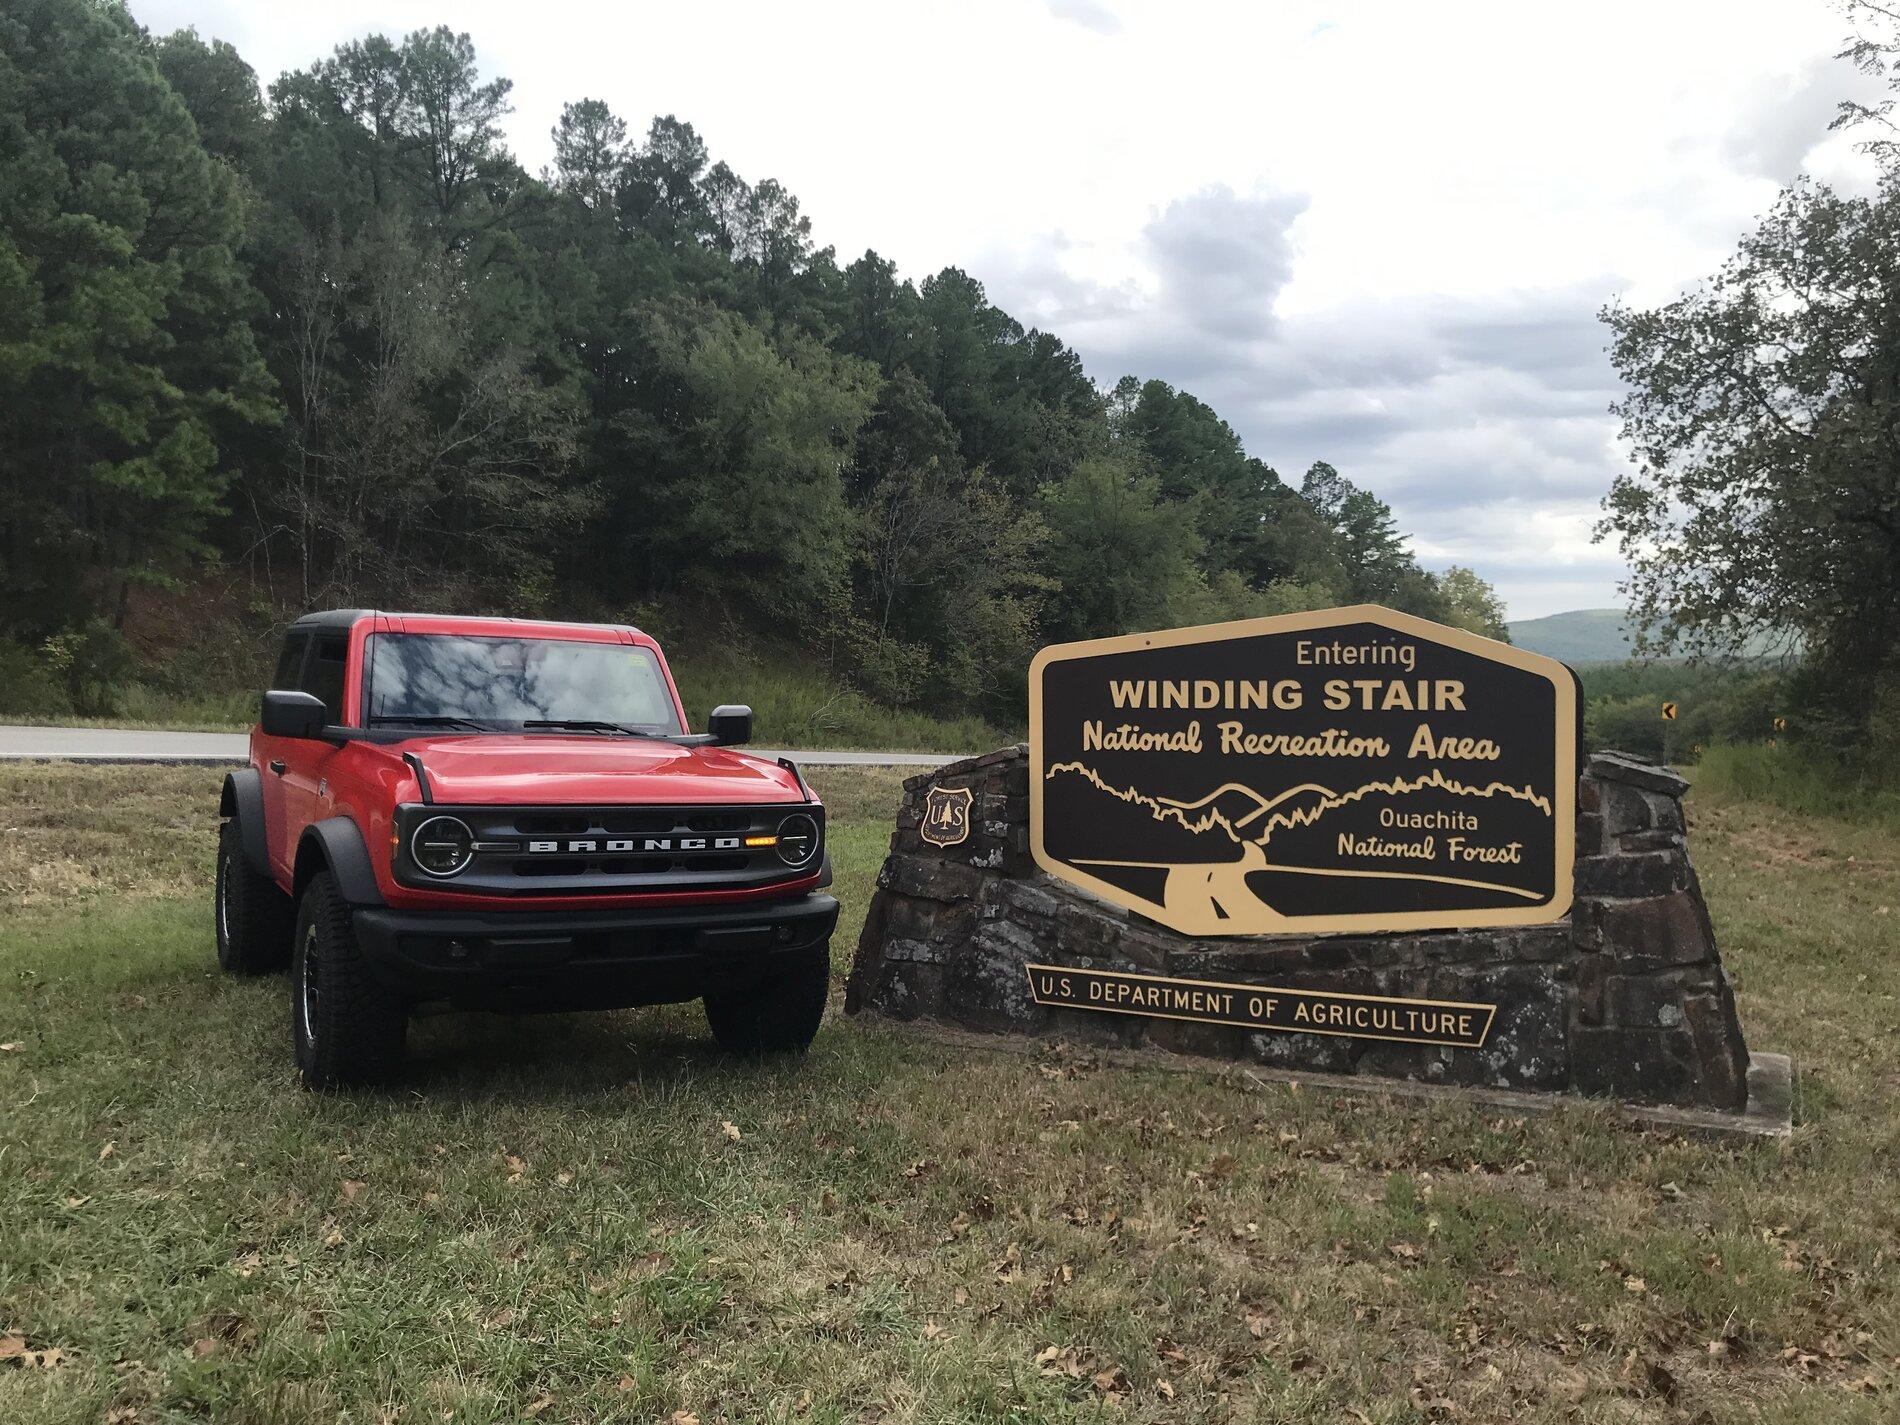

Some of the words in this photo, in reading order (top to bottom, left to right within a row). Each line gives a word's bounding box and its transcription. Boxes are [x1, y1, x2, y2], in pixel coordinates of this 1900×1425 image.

[1296, 640, 1416, 673] Entering
[1109, 679, 1303, 710] WINDING
[1323, 679, 1467, 711] STAIR
[1083, 720, 1203, 754] National
[1216, 720, 1391, 758] Recreation
[1406, 723, 1501, 761] Area
[1379, 807, 1479, 831] Ouachita
[529, 837, 740, 853] BRONCO
[1336, 832, 1436, 860] National
[1446, 836, 1523, 864] Forest
[1041, 976, 1077, 998] U.S.
[1089, 981, 1234, 1014] DEPARTMENT
[1248, 997, 1279, 1018] OF
[1293, 1002, 1473, 1037] AGRICULTURE
